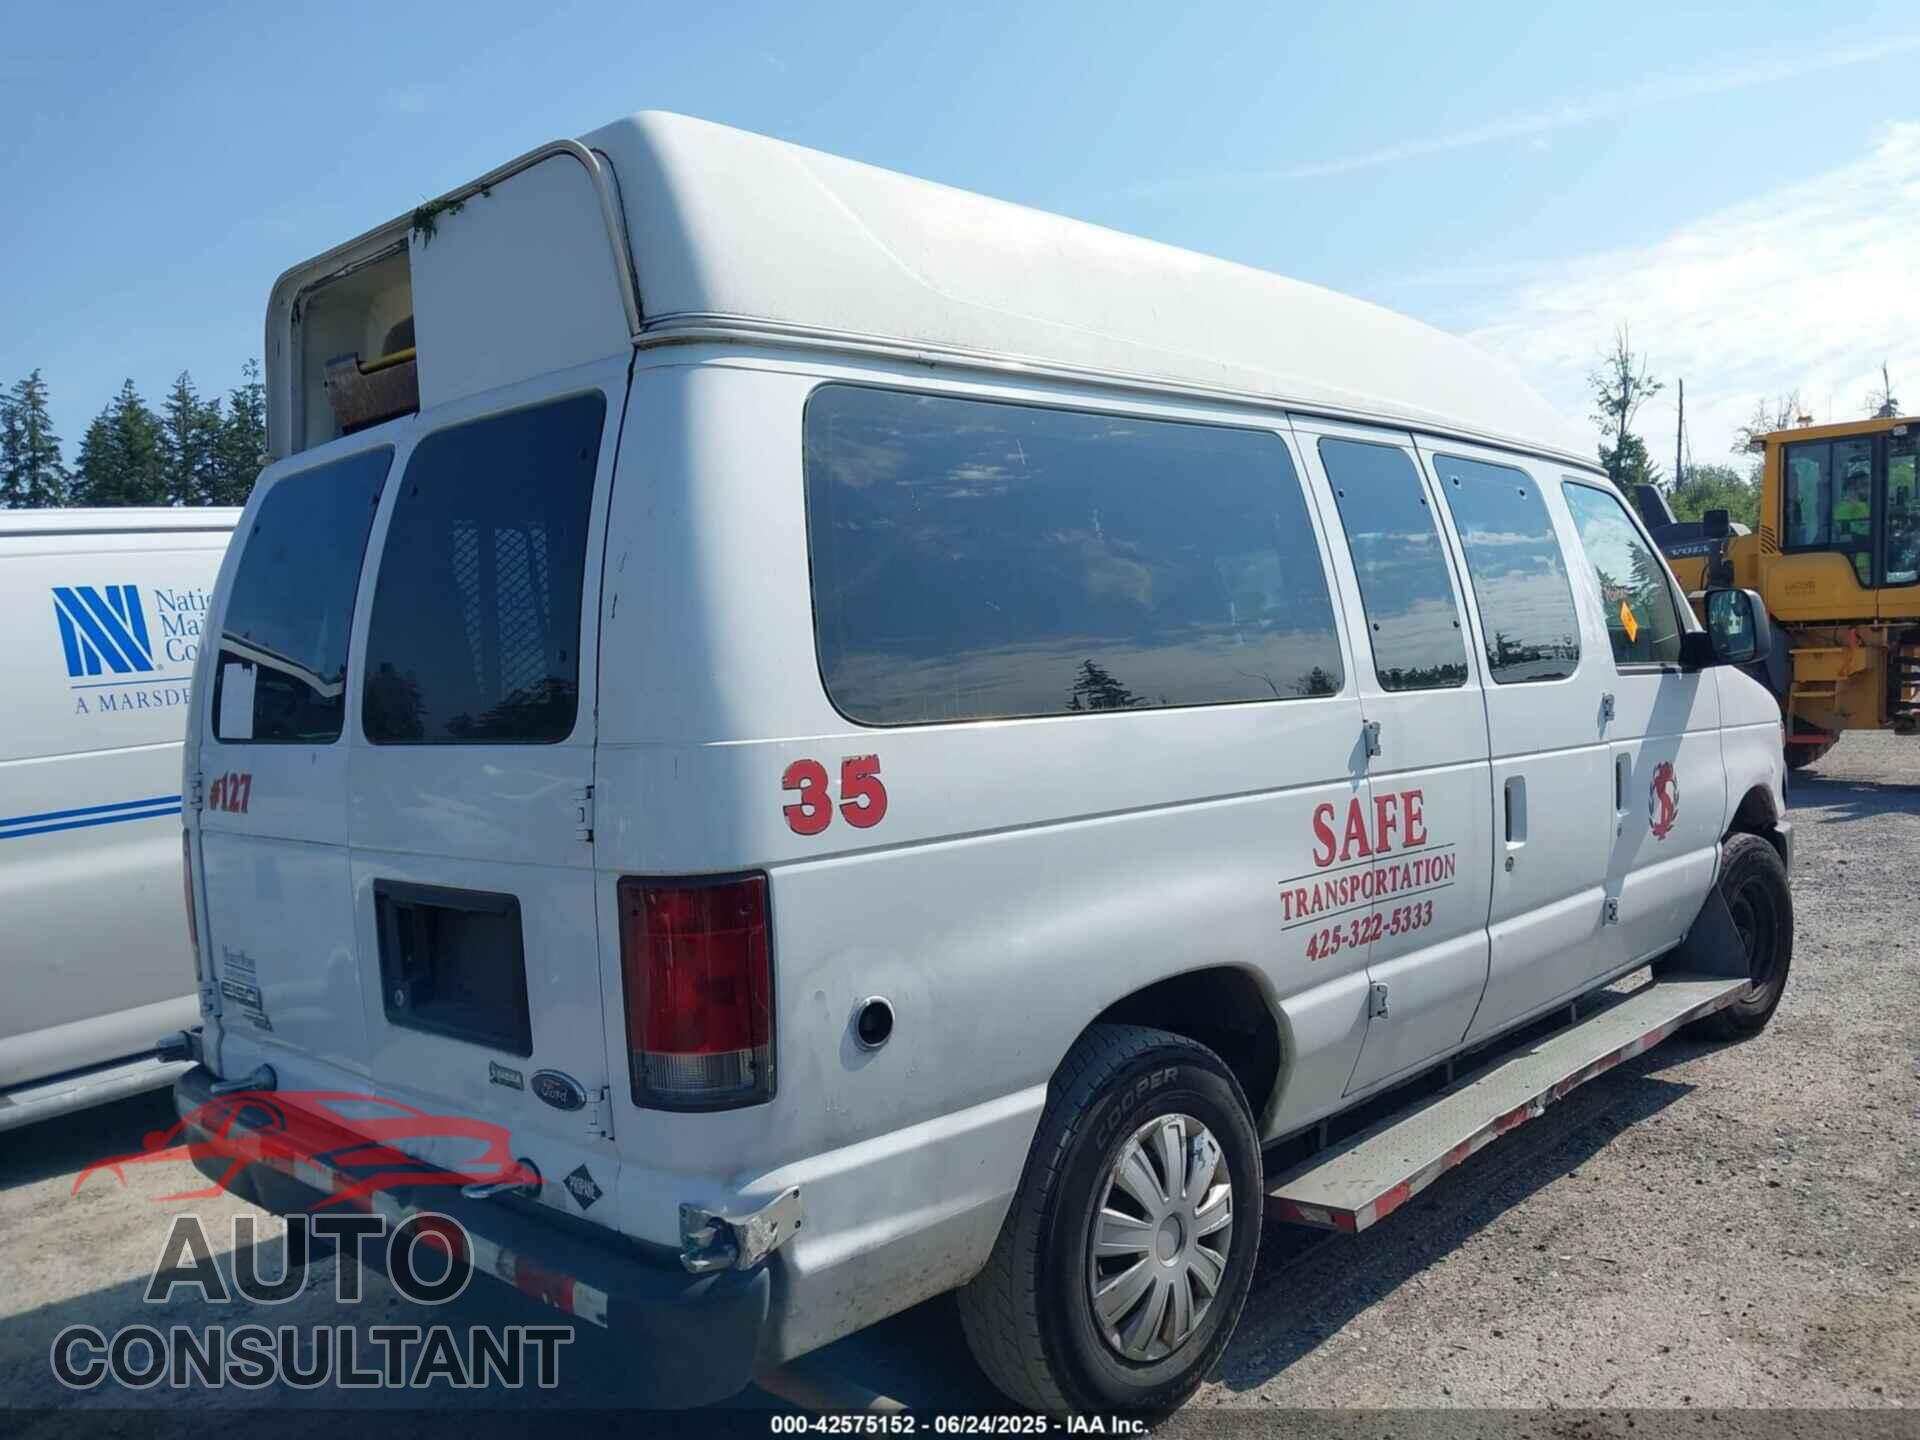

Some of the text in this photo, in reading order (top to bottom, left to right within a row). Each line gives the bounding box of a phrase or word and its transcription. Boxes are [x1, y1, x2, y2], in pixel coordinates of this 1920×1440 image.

[75, 696, 89, 715] A
[209, 770, 252, 814] #127
[782, 753, 888, 836] 35
[1312, 789, 1428, 868] SAFE
[1279, 853, 1457, 922] TRANSPORTATION
[1305, 900, 1434, 961] 425-322-5333
[1095, 1066, 1179, 1151] COOPER
